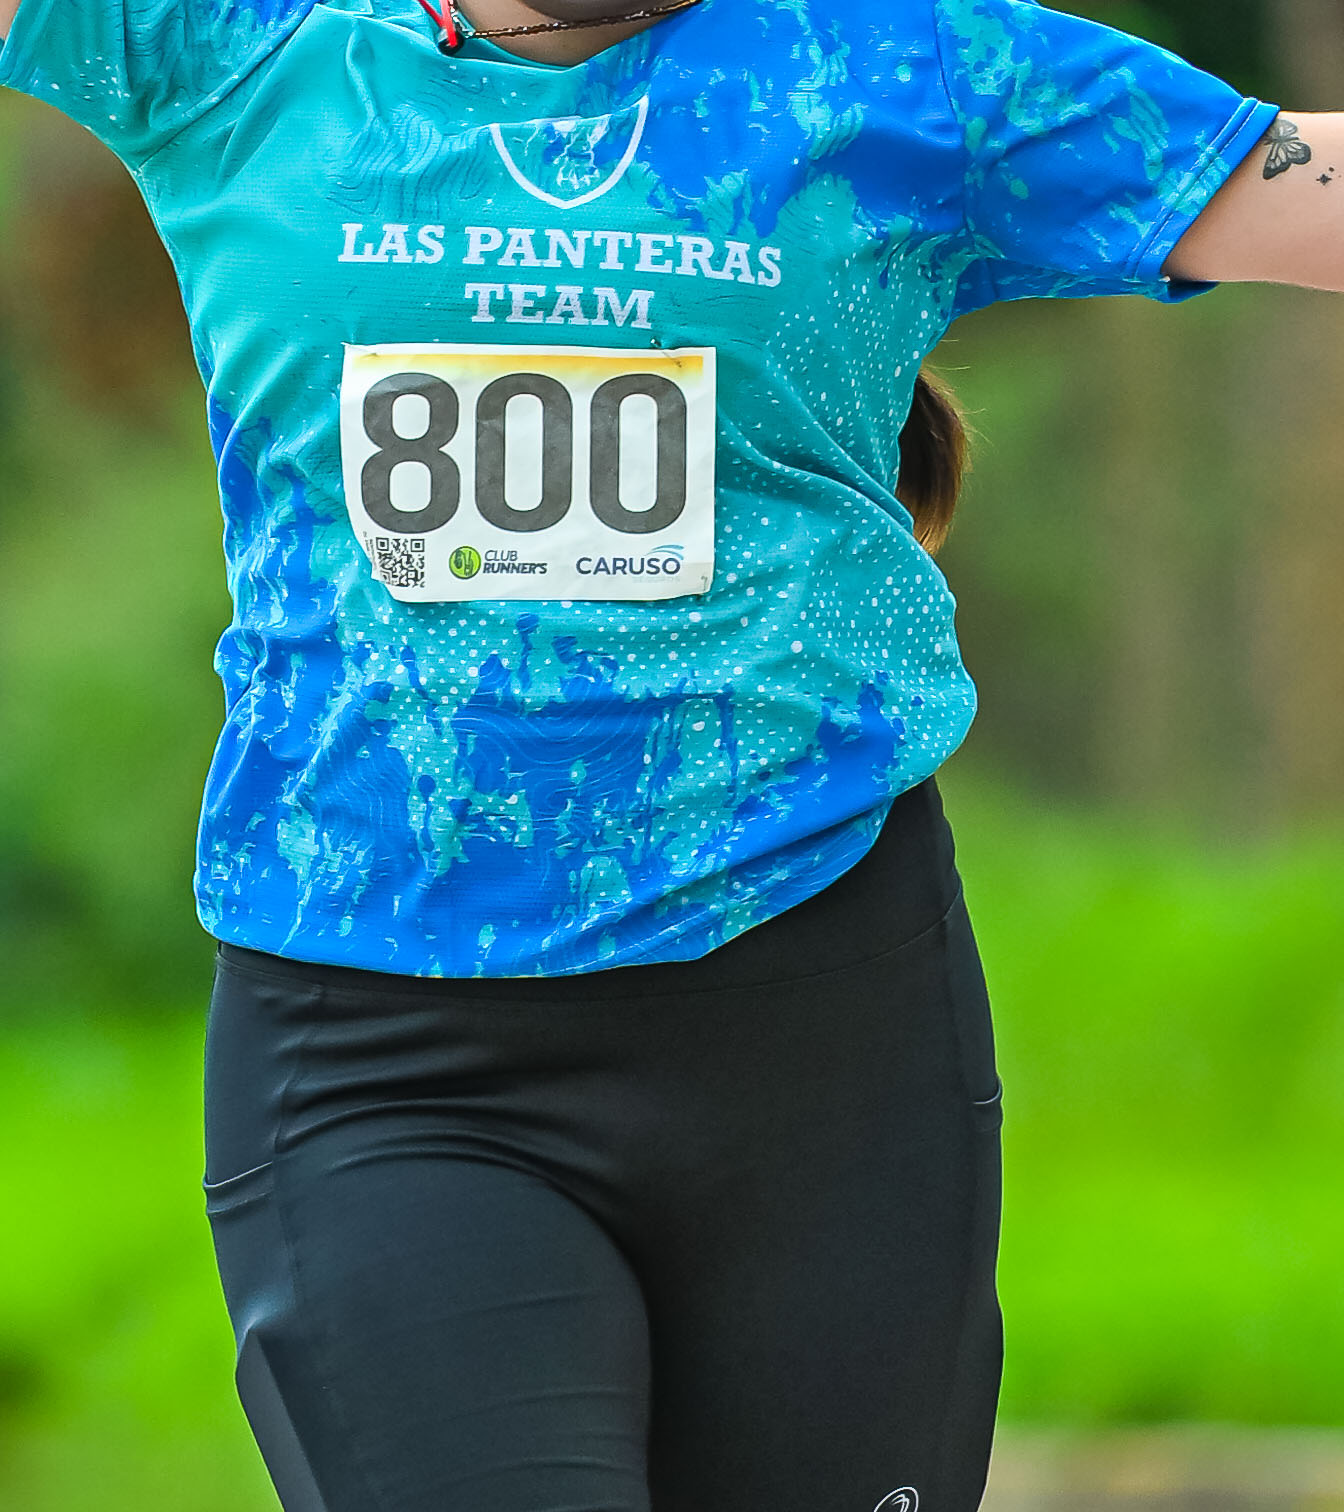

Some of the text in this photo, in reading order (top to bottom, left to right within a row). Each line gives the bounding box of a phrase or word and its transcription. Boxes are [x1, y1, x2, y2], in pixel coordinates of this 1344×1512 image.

[337, 222, 782, 288] LAS PANTERAS
[464, 282, 655, 329] TEAM
[360, 372, 687, 535] 800
[482, 561, 548, 575] RUNNER'S
[484, 549, 518, 562] CLUB
[576, 557, 681, 576] CARUSO
